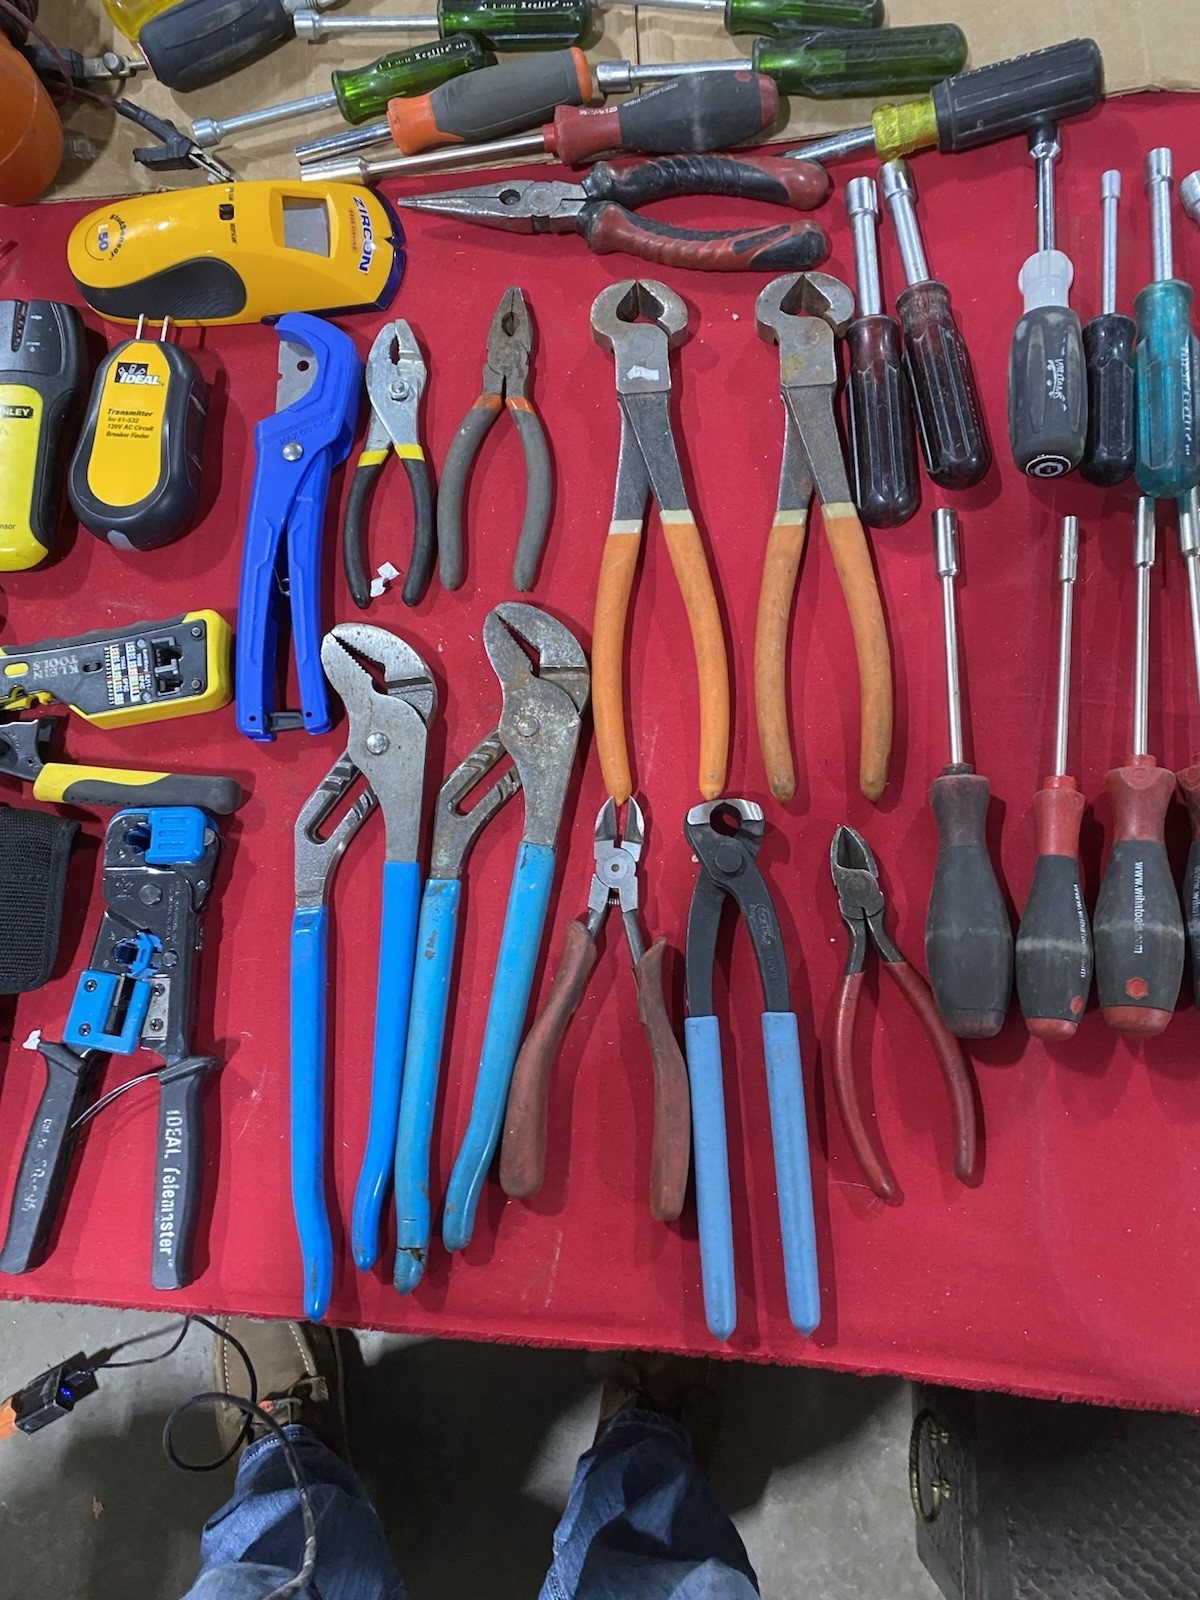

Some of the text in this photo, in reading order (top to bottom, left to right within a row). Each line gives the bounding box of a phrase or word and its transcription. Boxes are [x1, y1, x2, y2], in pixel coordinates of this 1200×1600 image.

[97, 223, 109, 252] L50
[352, 196, 374, 273] ZIRCON
[119, 372, 161, 386] IDEAL
[0, 407, 30, 417] NLEY
[107, 408, 154, 417] Transmitter
[32, 654, 79, 671] TOOLS
[32, 663, 79, 681] KLEIN
